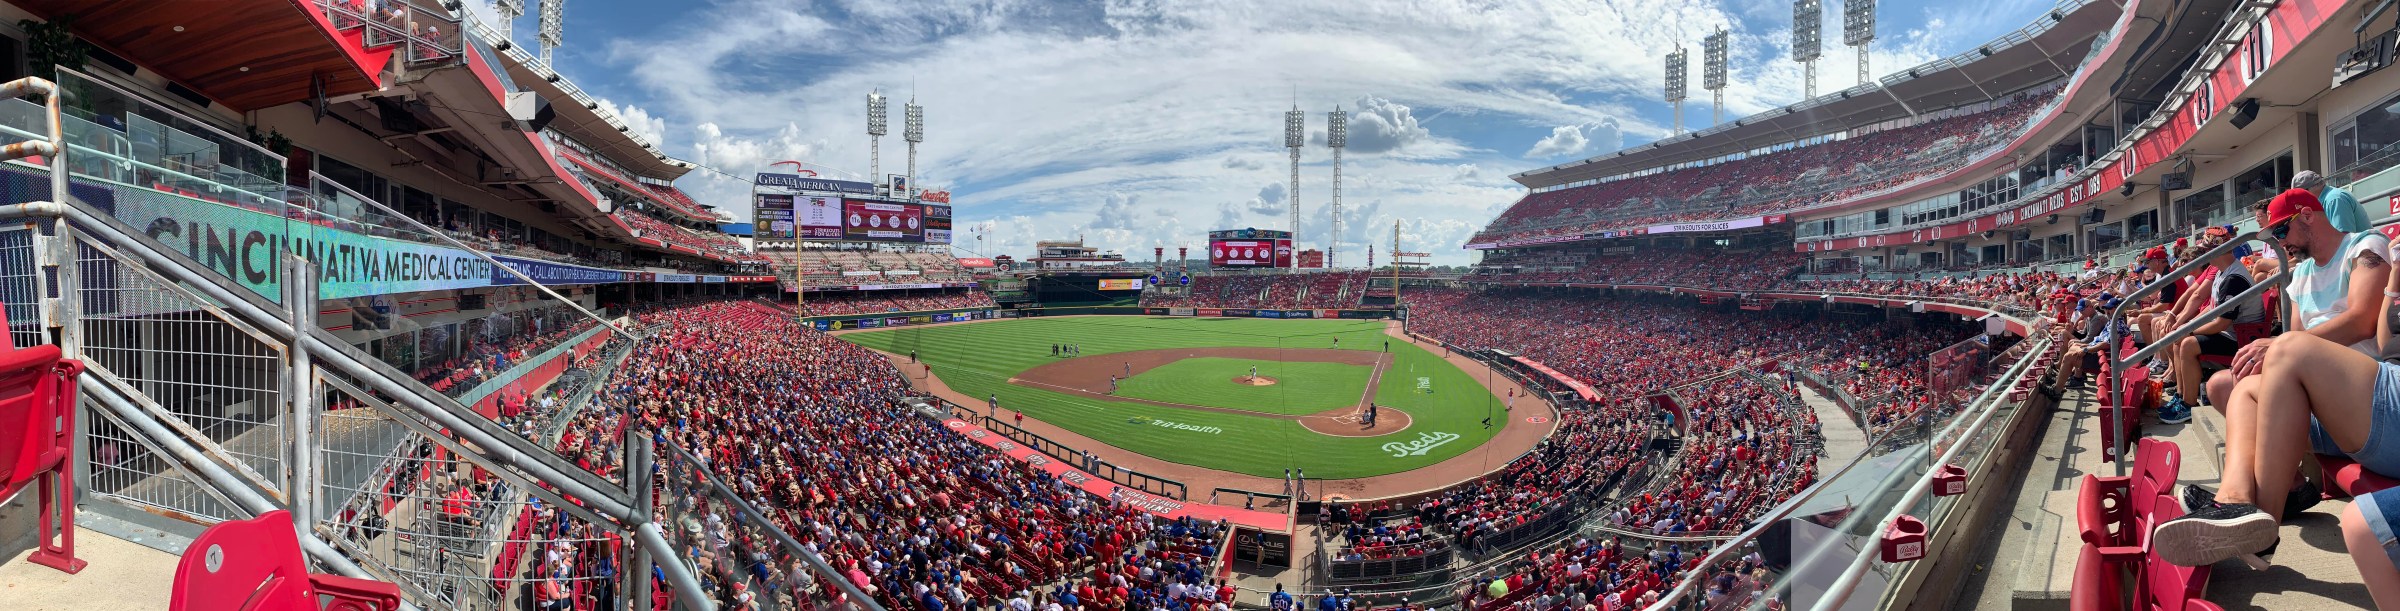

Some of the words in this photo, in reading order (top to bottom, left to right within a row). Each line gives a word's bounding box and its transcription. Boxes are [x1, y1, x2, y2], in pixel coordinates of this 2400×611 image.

[2243, 21, 2265, 81] 11
[758, 174, 792, 185] GREAT
[790, 179, 841, 191] AMERICAN
[2020, 199, 2048, 221] CINCINNATI
[2049, 192, 2065, 211] REDS
[2070, 184, 2087, 204] EST.
[2087, 174, 2101, 197] 1869
[2392, 197, 2400, 213] 2
[935, 208, 951, 216] PNC
[1673, 224, 1701, 232] STRIKEOUTS
[360, 247, 382, 283] VA
[385, 249, 452, 284] MEDICAL
[454, 255, 490, 281] CENTER
[534, 264, 547, 280] CALL
[1151, 418, 1223, 436] TriHealth
[1381, 431, 1460, 458] Reds
[1064, 470, 1086, 483] 1972
[1108, 493, 1172, 514] CAMPIONS
[1150, 497, 1184, 510] LEAGUE
[1251, 538, 1285, 549] LXUS
[1203, 590, 1213, 600] 42
